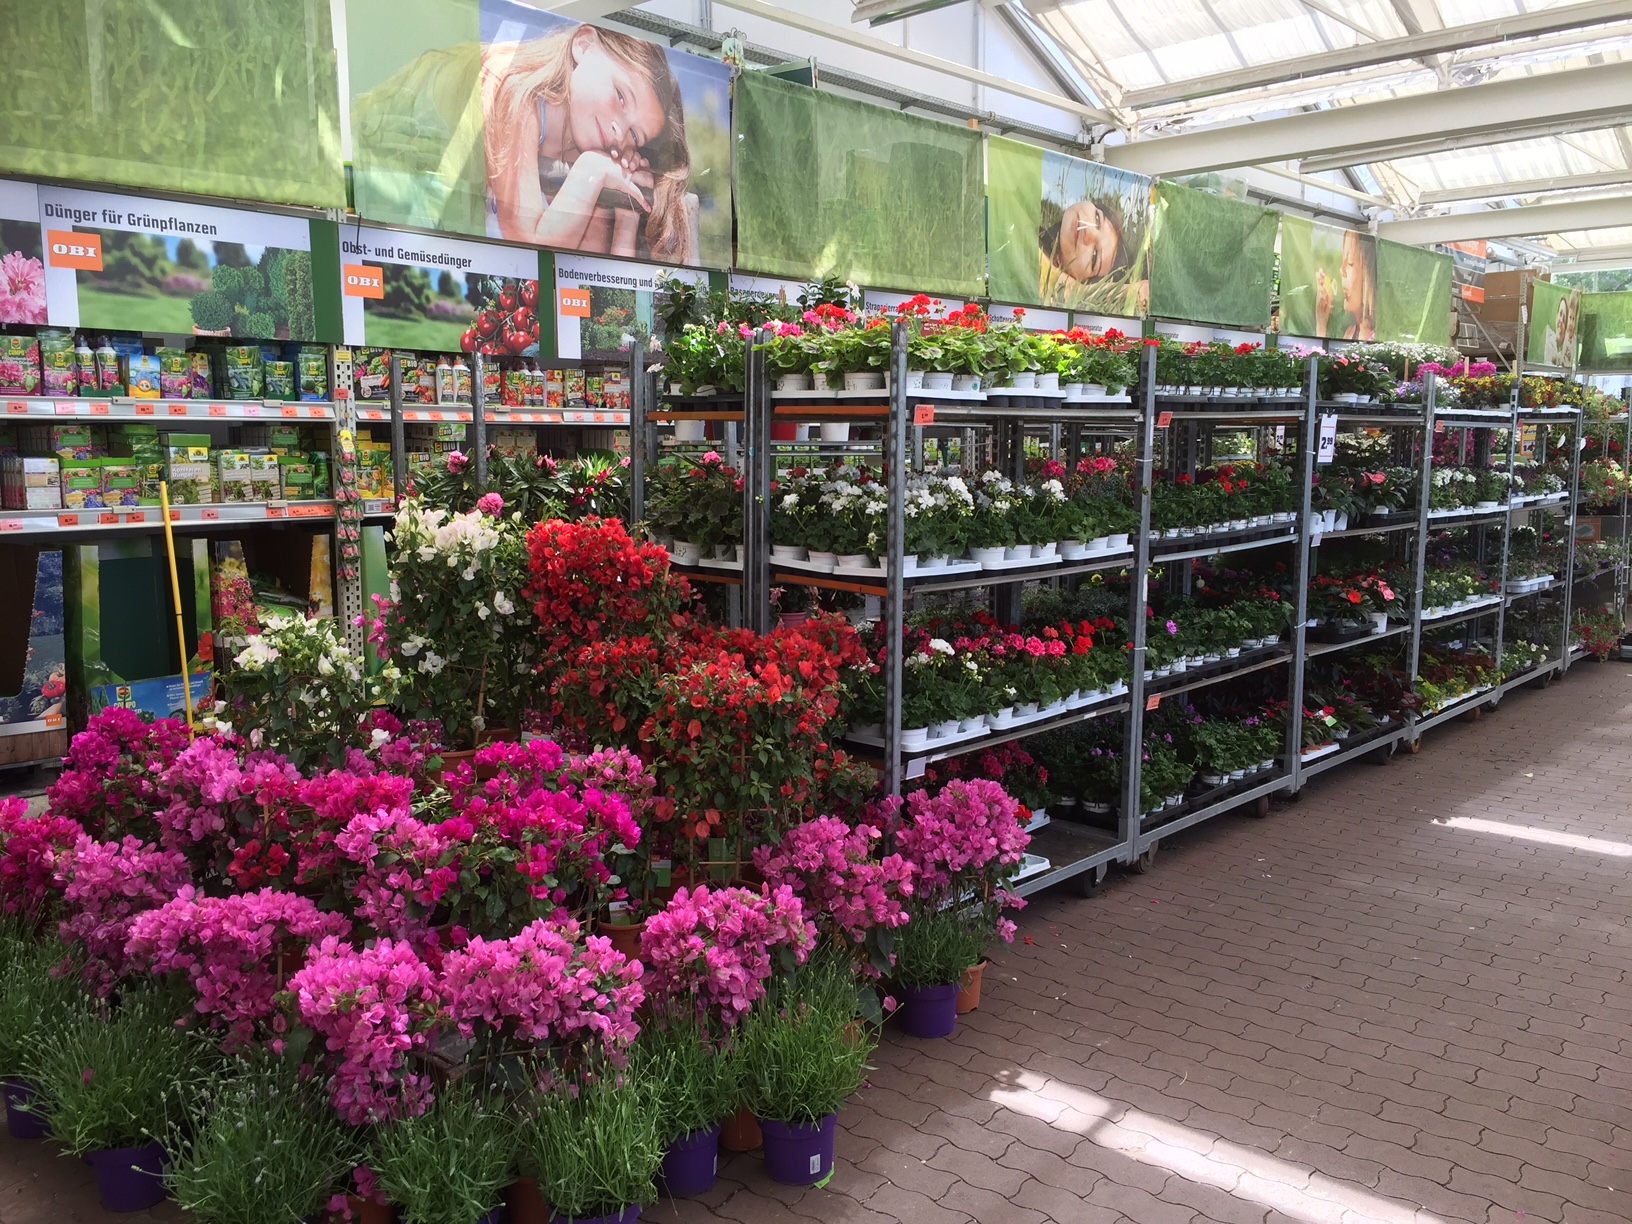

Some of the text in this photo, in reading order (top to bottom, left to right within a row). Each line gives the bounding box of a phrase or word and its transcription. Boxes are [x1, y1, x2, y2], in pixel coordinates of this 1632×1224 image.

[44, 203, 218, 236] Dünger für Grünpflanzen
[52, 243, 97, 258] OBI
[342, 240, 472, 268] Obst- und Gemüsedünger
[346, 275, 380, 288] OBI
[558, 267, 638, 289] Bodenverbesserung
[638, 277, 653, 288] und
[562, 297, 588, 308] OBI
[1320, 436, 1334, 450] 2.99
